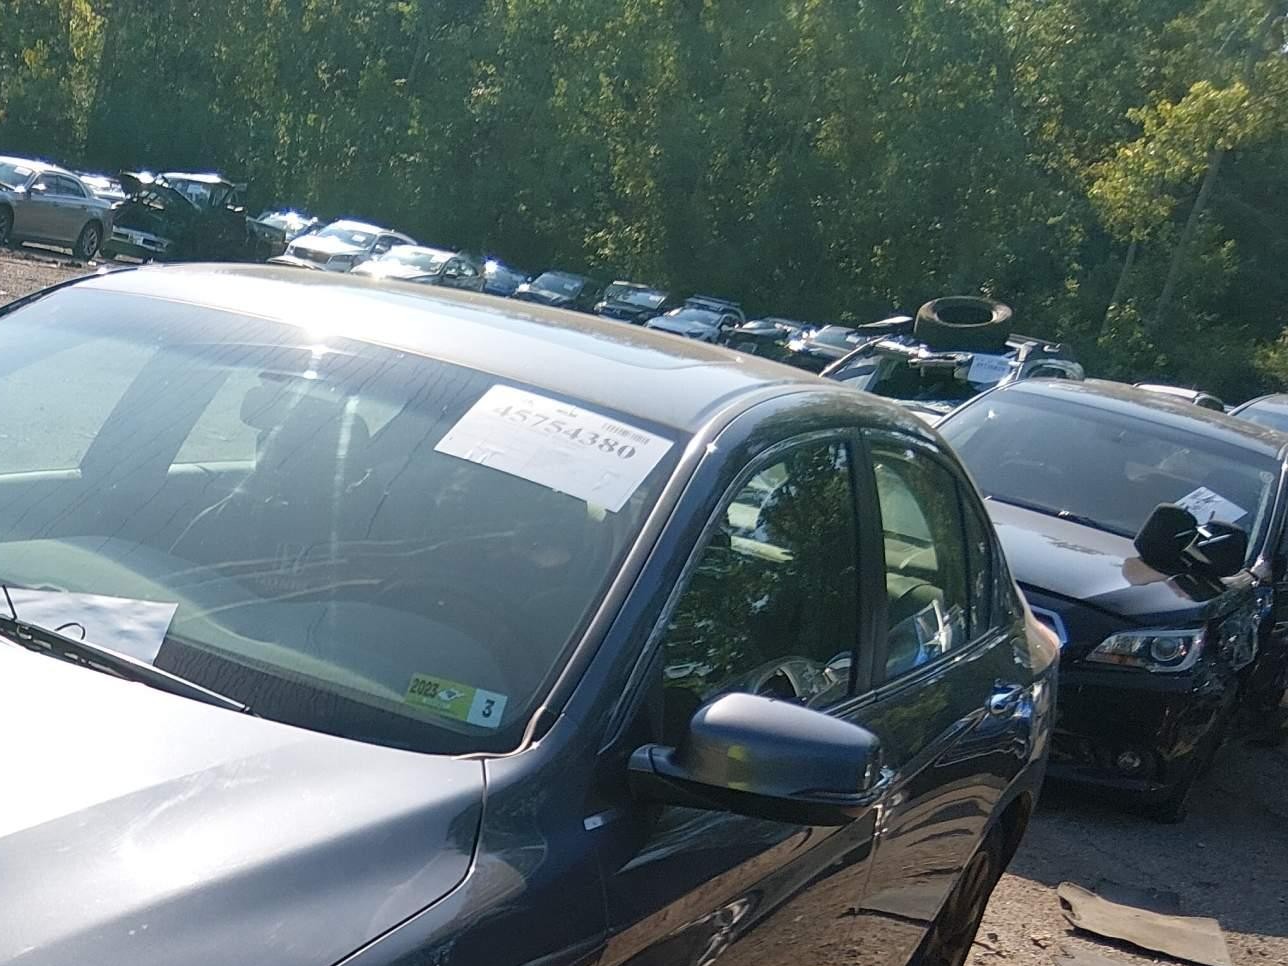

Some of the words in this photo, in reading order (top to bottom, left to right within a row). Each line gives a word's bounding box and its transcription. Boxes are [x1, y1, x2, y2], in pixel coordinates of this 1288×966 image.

[493, 405, 637, 460] 45754380
[409, 678, 440, 698] 2023
[482, 699, 496, 718] 3
